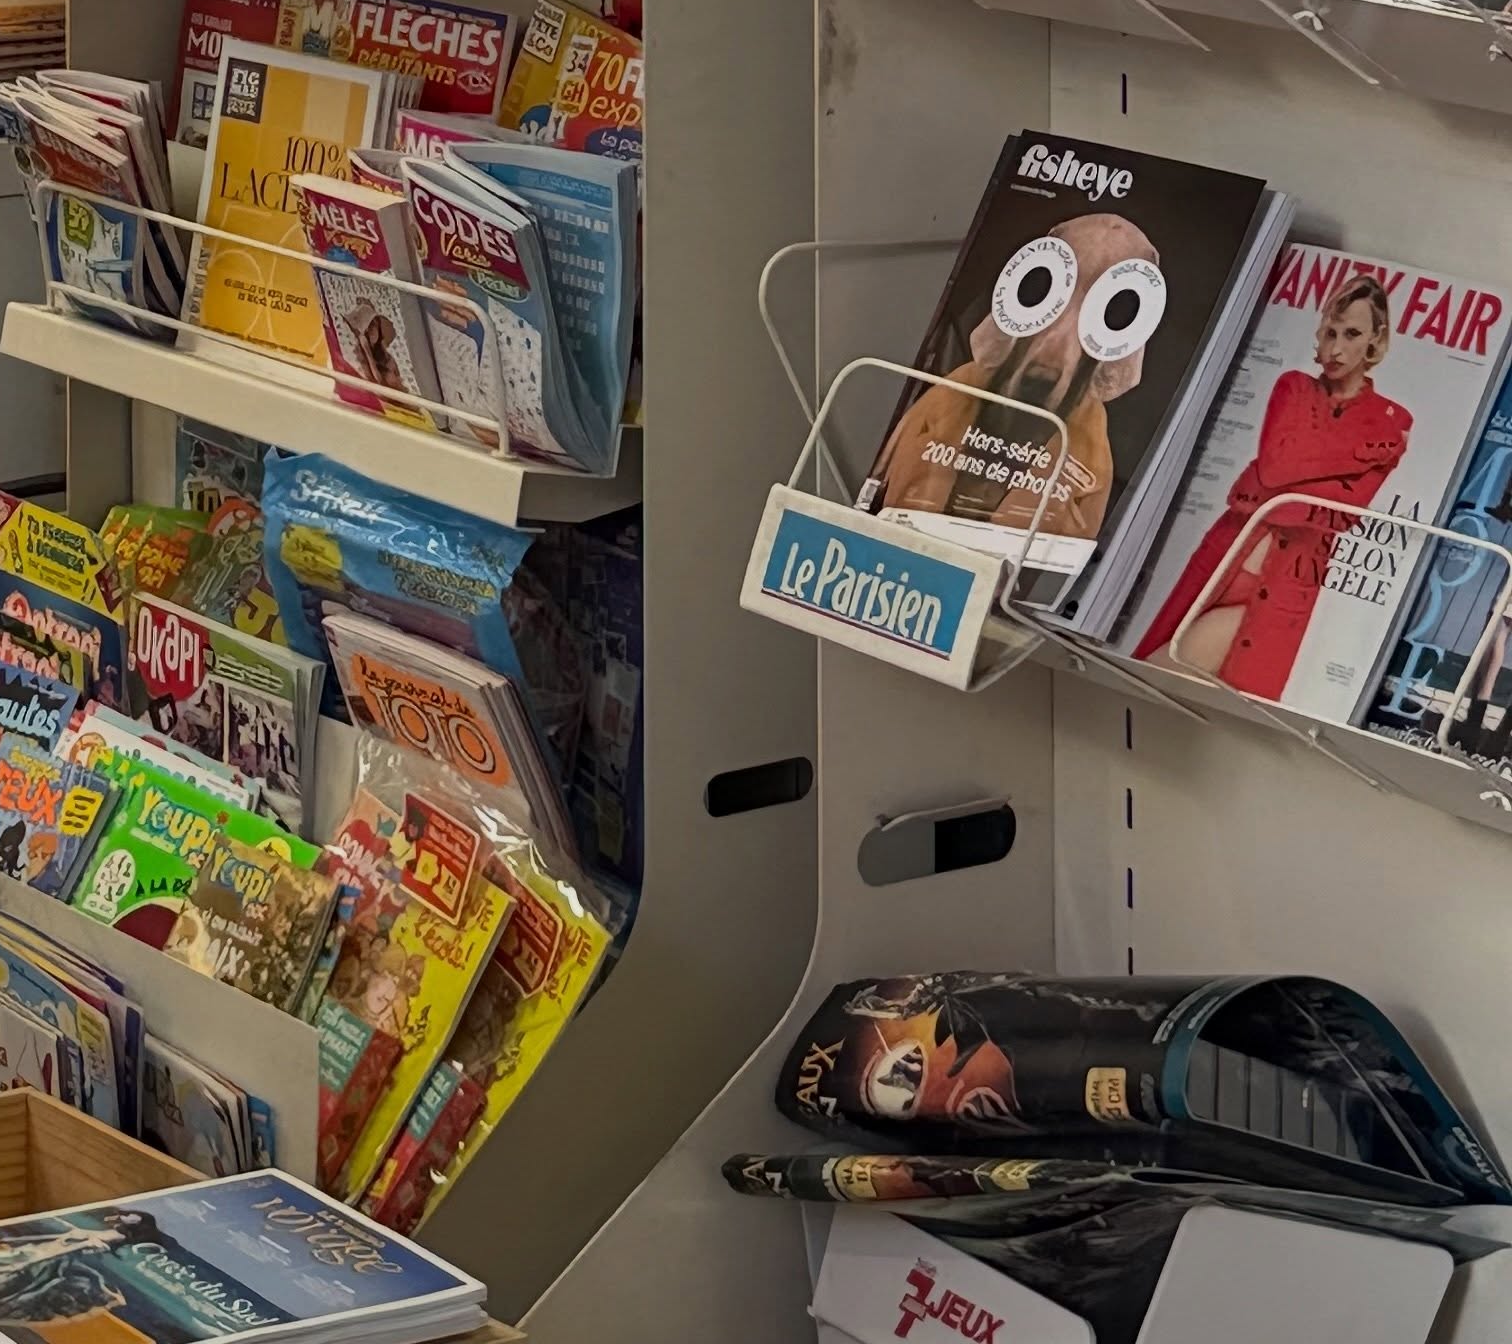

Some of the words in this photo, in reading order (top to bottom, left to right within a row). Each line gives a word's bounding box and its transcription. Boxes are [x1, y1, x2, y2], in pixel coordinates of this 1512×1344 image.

[354, 0, 502, 67] FLÉCHÉS
[1018, 142, 1136, 203] fisheye
[1396, 278, 1504, 356] FAIR
[959, 424, 1055, 470] Hors-série
[810, 542, 942, 646] Parisien
